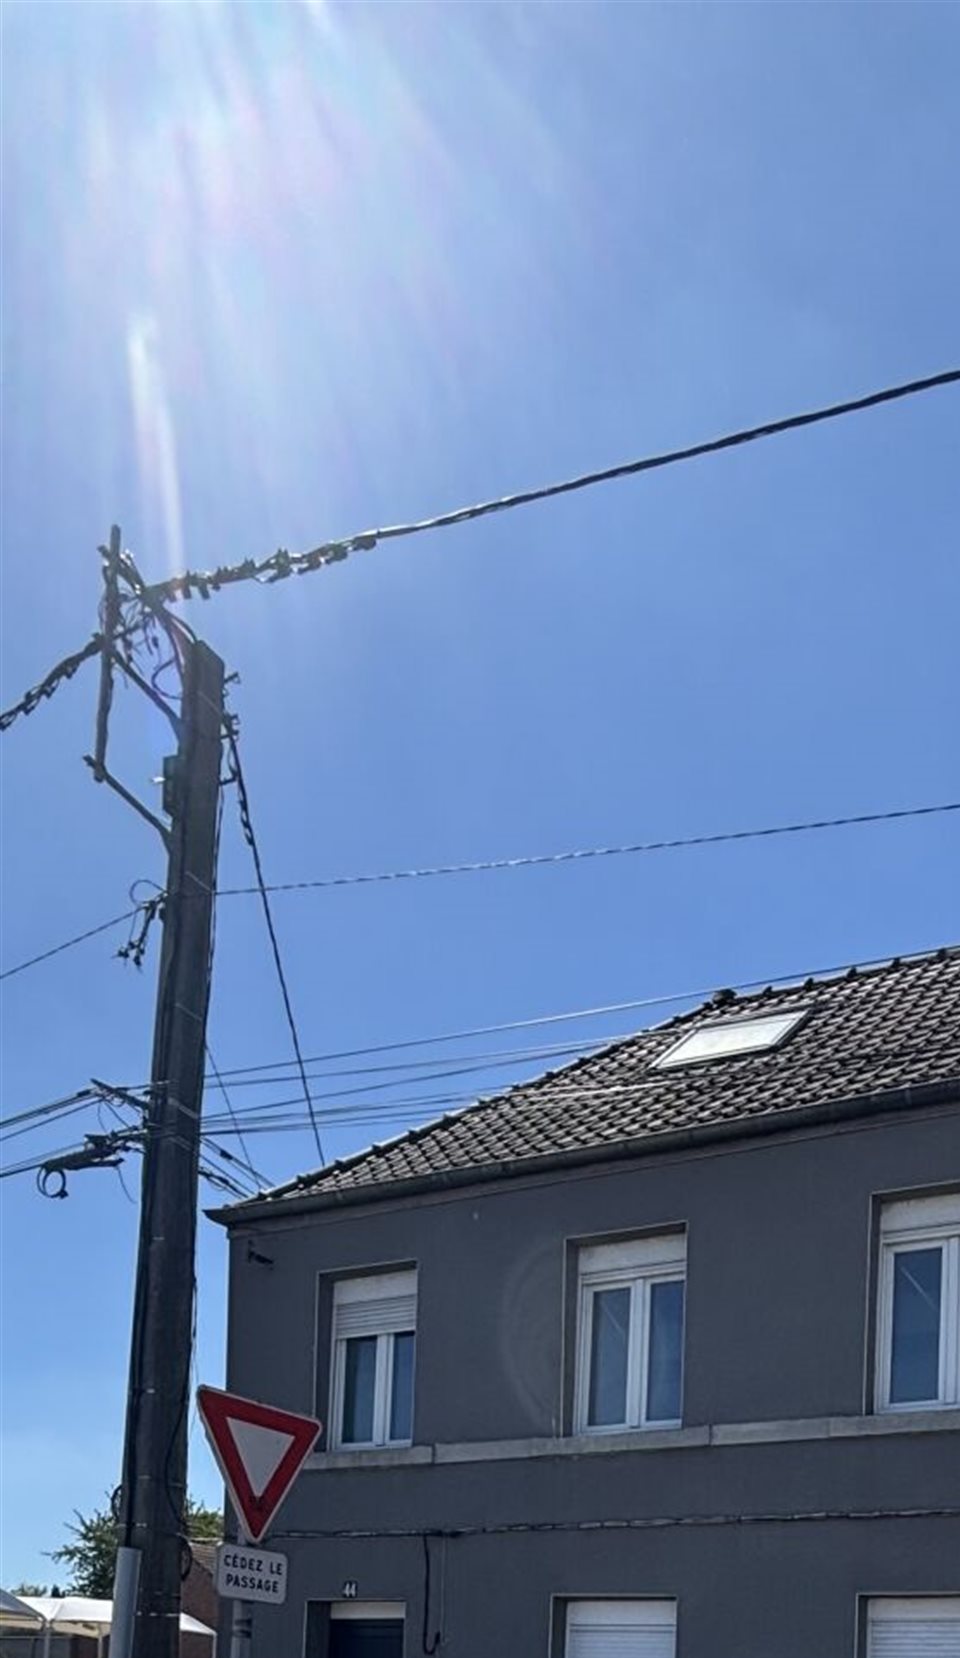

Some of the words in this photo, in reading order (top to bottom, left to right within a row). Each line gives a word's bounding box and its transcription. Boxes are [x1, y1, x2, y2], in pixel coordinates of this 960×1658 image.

[223, 1554, 263, 1572] CÉDEZ
[269, 1561, 283, 1576] LE
[226, 1573, 279, 1593] PASSAGE
